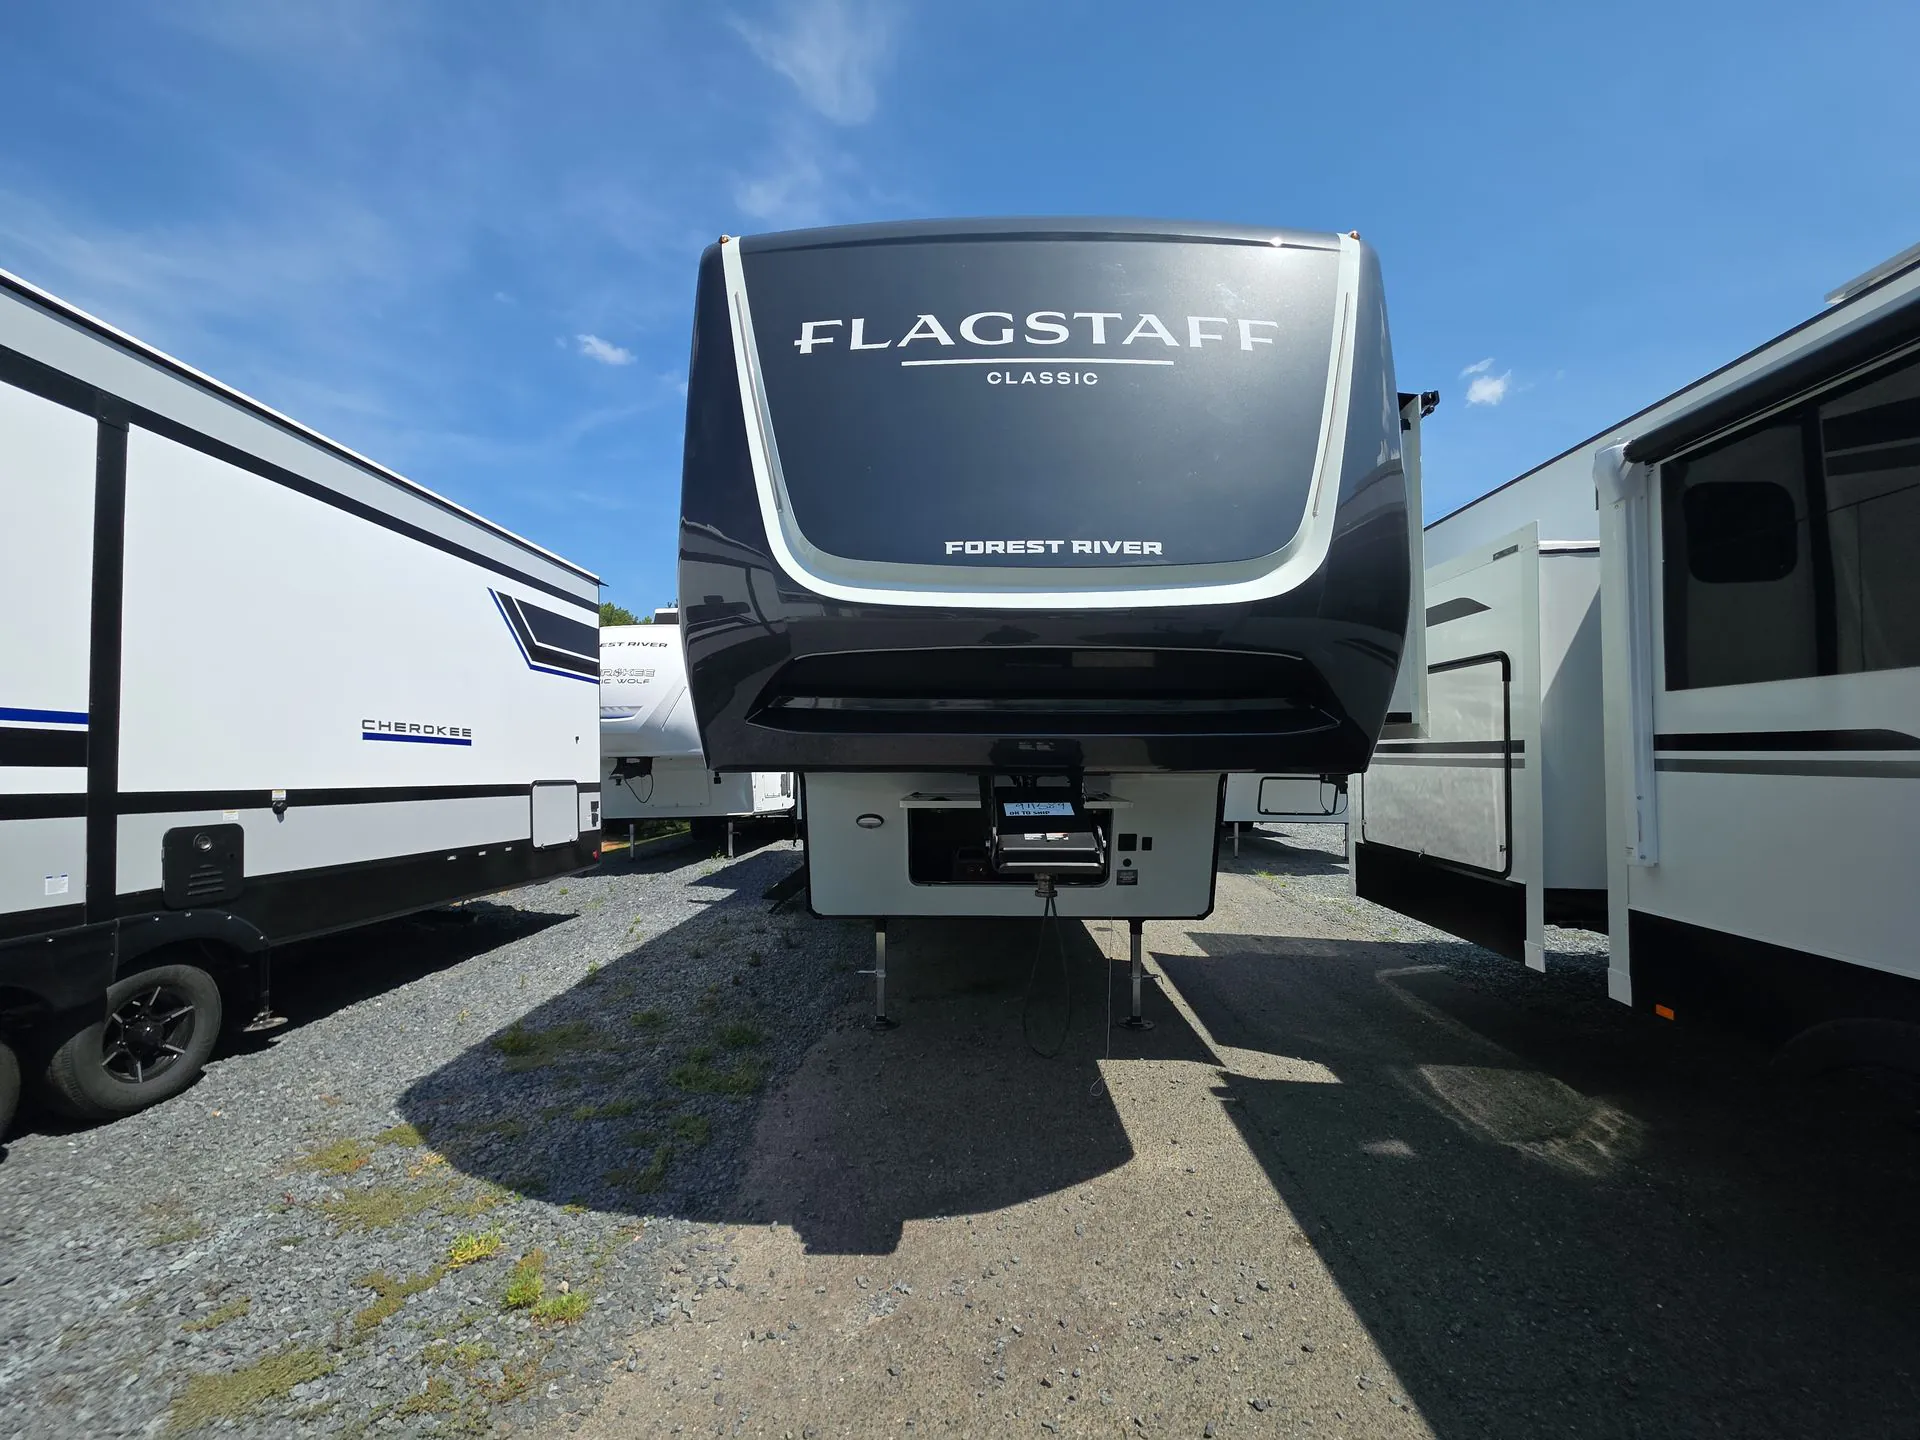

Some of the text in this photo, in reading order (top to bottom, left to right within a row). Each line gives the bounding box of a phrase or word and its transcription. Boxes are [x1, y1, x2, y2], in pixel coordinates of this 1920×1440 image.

[794, 311, 1279, 354] FLAGSTAFF
[986, 371, 1099, 386] CLASSIC
[944, 540, 1163, 556] FOREST RIVER
[361, 719, 472, 738] CHEROKEE
